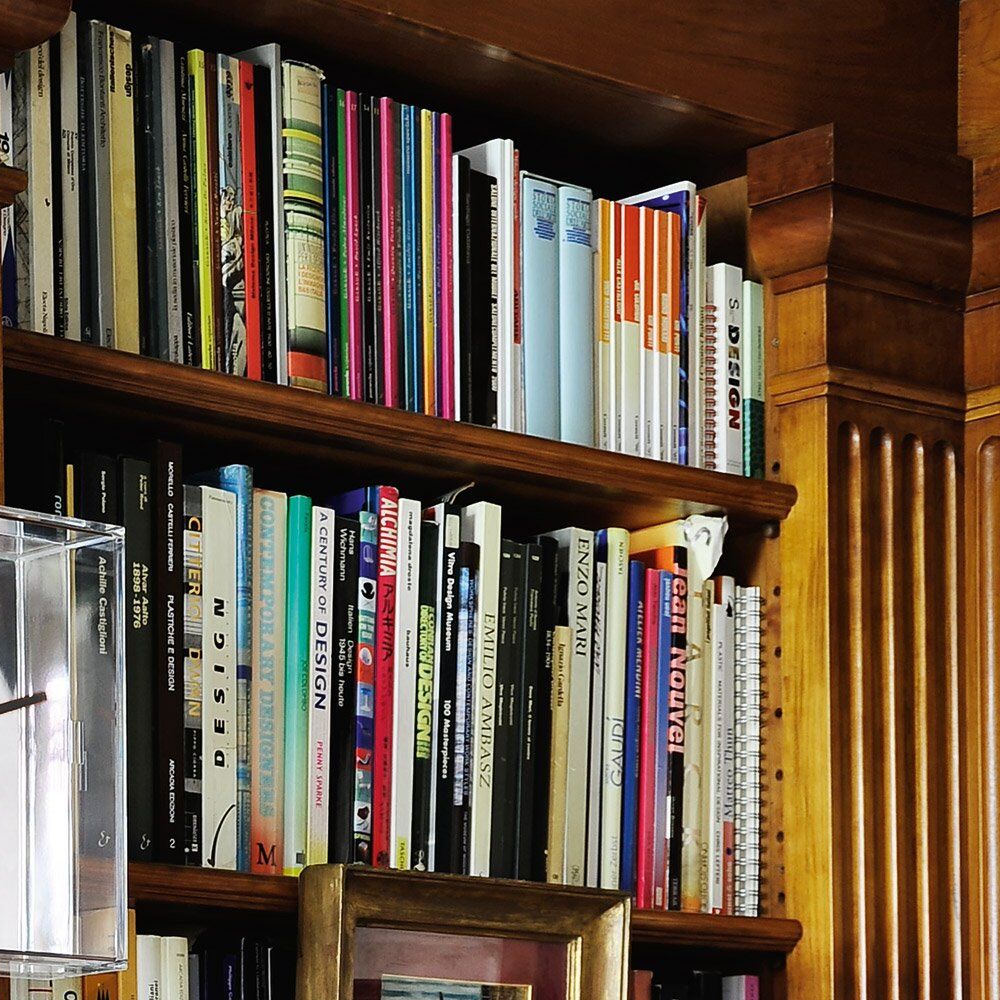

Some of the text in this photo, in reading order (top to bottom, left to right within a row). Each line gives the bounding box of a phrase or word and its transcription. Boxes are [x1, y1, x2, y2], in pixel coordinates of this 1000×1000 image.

[125, 64, 134, 98] design
[41, 291, 49, 312] Electa
[728, 324, 741, 430] DESIGN
[167, 461, 175, 572] MORELLO CASTELLI FERRIERI
[348, 529, 356, 555] Hans
[379, 497, 399, 577] ALCHIMIA
[406, 511, 414, 561] magdalena
[339, 528, 348, 582] Wichmann
[97, 556, 108, 655] Achille Castiglioni
[132, 561, 142, 629] 1898-1976
[141, 564, 150, 625] Alvar Aalto
[186, 515, 203, 718] CITTERIO DWAN
[314, 512, 329, 711] A CENTURY OF DESIGN
[445, 551, 456, 652] Vitra Design Museum
[575, 537, 590, 657] ENZO MARI
[166, 594, 175, 692] PLASTICHE DESIGN
[259, 496, 275, 818] CONTEMPORARY DESIGNERS
[338, 637, 346, 661] 1945
[345, 604, 355, 675] Italien Design
[668, 562, 688, 755] Jean Nouvel
[213, 596, 227, 768] DESIGN
[338, 679, 346, 707] heute
[479, 613, 496, 789] EMILIO AMBASZ
[556, 643, 566, 708] Ignazio Gardella
[315, 740, 324, 809] PENNY SPARKE
[441, 699, 451, 779] 100 Masterpieces
[605, 716, 624, 788] GAUDÍ
[168, 759, 176, 792] ARCADIA
[168, 838, 176, 849] 2
[256, 841, 278, 867] M
